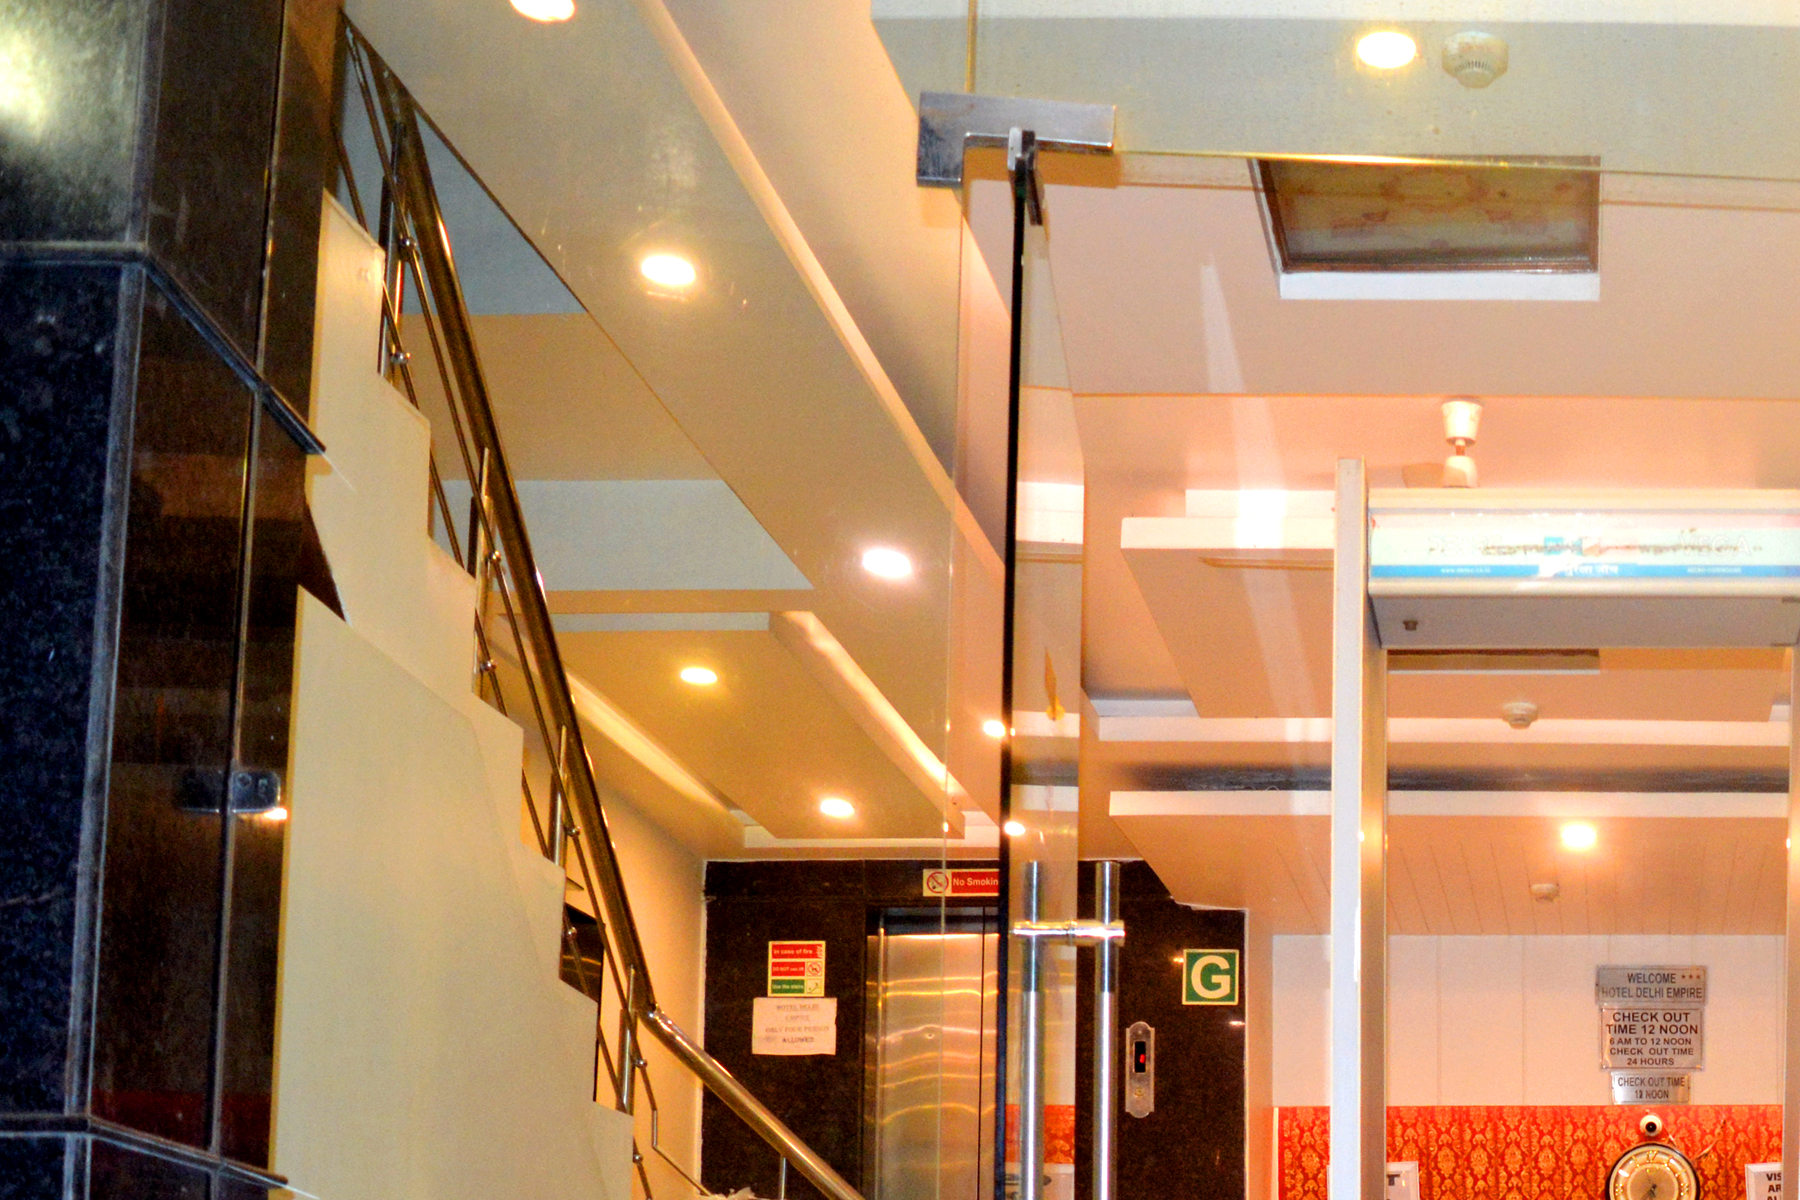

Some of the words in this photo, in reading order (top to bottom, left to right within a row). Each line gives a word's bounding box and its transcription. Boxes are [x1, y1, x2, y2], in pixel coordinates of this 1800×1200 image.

[953, 878, 965, 886] No
[967, 877, 998, 886] Smokin
[1191, 955, 1230, 999] G
[1627, 972, 1676, 984] WELCOME
[1601, 987, 1635, 998] HOTEL
[1636, 987, 1664, 998] DELHI
[1666, 987, 1702, 998] EMPIRE
[1612, 1012, 1659, 1023] CHECK
[1663, 1012, 1690, 1022] OUT
[1605, 1024, 1636, 1034] TIME
[1641, 1024, 1655, 1034] 12
[1659, 1024, 1698, 1034] NOON
[1609, 1037, 1615, 1045] 6
[1617, 1037, 1632, 1045] AM
[1634, 1037, 1647, 1045] TO
[1650, 1037, 1661, 1045] 12
[1663, 1037, 1692, 1045] NOON
[1609, 1047, 1644, 1056] CHECK
[1648, 1047, 1668, 1055] OUT
[1671, 1047, 1694, 1055] TIME
[1626, 1057, 1638, 1066] 24
[1640, 1057, 1675, 1065] HOURS
[1617, 1077, 1646, 1087] CHECK
[1647, 1077, 1664, 1087] OUT
[1666, 1076, 1685, 1087] TIME
[1645, 1089, 1669, 1099] NOON
